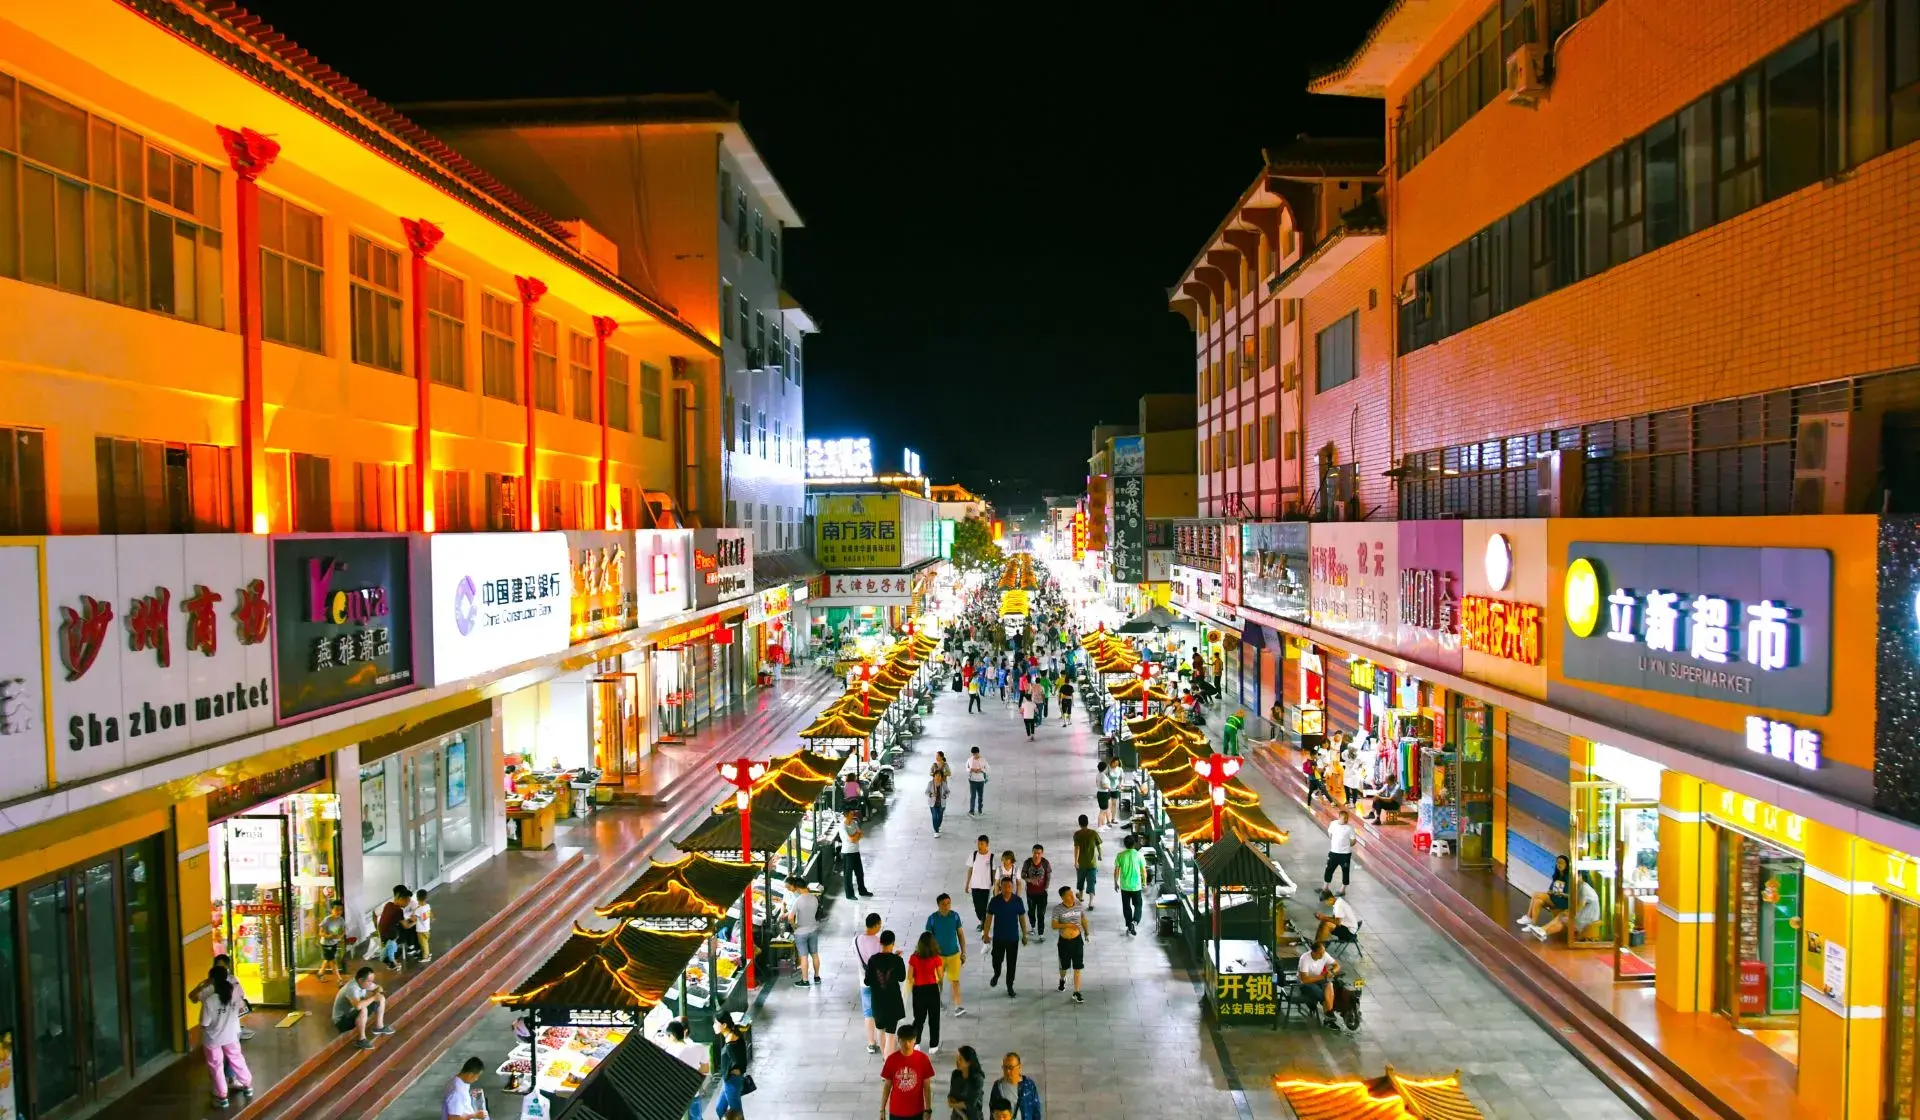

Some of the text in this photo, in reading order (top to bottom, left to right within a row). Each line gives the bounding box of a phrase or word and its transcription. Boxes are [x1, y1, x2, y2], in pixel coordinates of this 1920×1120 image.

[1126, 478, 1140, 517] 客栈
[822, 521, 895, 540] 南方家居
[482, 572, 561, 606] 中国建设银行
[835, 578, 906, 594] 天津包子馆
[1607, 588, 1790, 671] 立新超市
[317, 627, 391, 671] 燕雅潮品
[1638, 656, 1752, 694] LI XIN SUPERMARKET
[69, 678, 269, 751] Sha zhou market
[1218, 975, 1273, 1001] 开锁
[1220, 1002, 1276, 1015] 公安局指定
